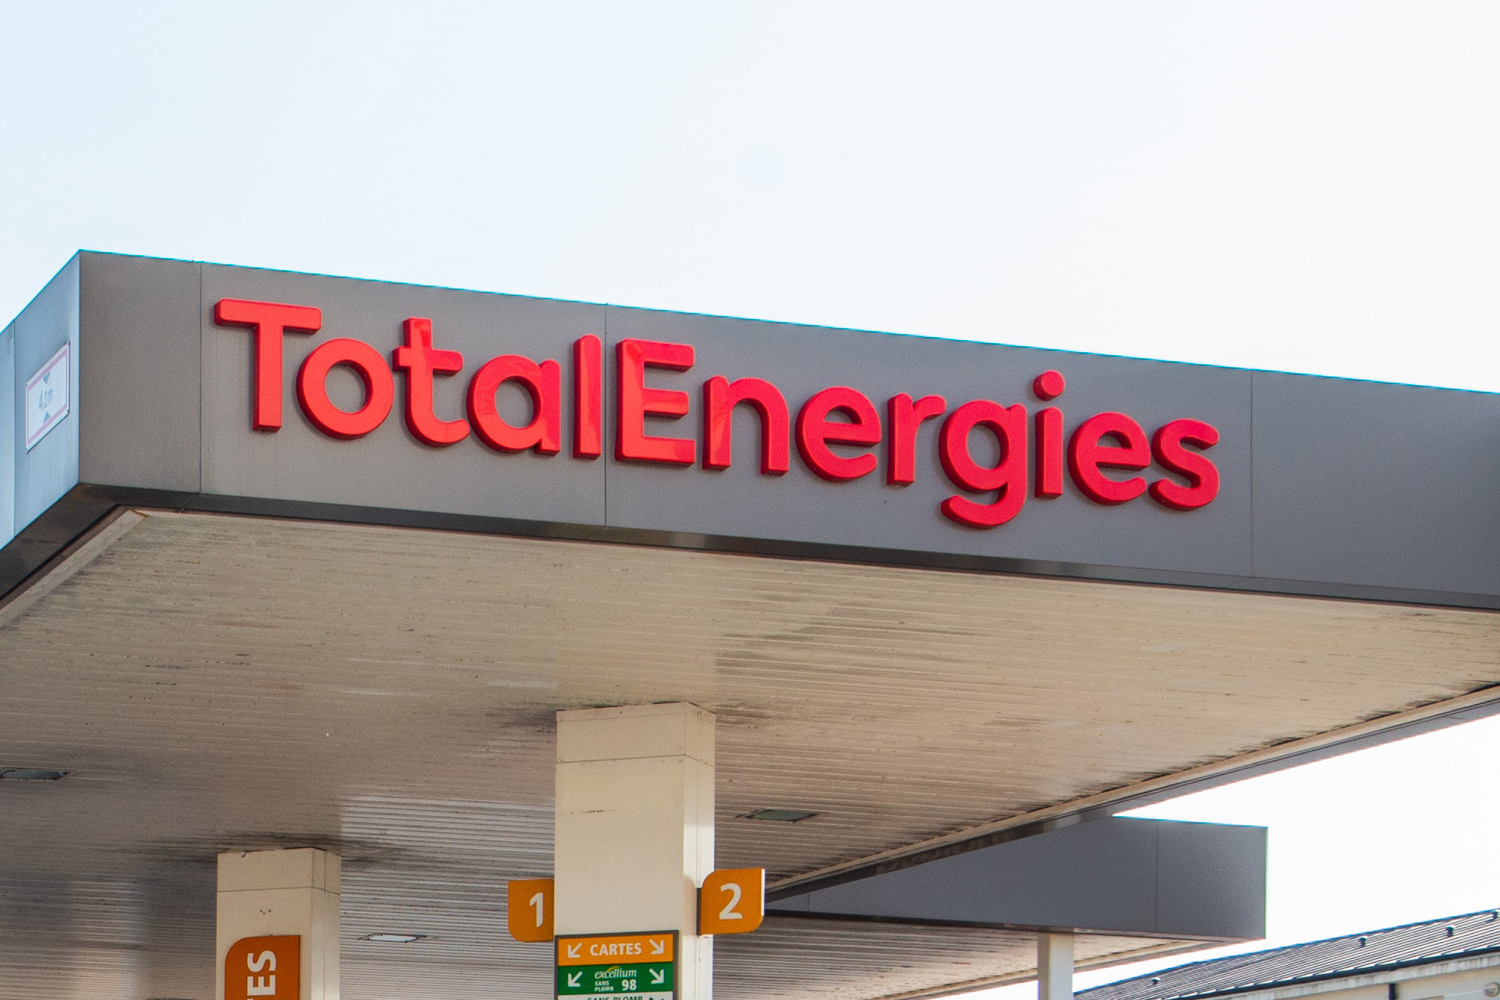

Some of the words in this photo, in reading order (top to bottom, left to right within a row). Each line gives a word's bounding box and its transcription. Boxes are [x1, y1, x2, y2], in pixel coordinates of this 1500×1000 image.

[213, 298, 1220, 529] TotalEnergies
[529, 892, 544, 928] 1
[719, 882, 743, 920] 2
[589, 942, 642, 957] CARTES
[594, 967, 637, 979] excellium
[621, 979, 637, 991] 98
